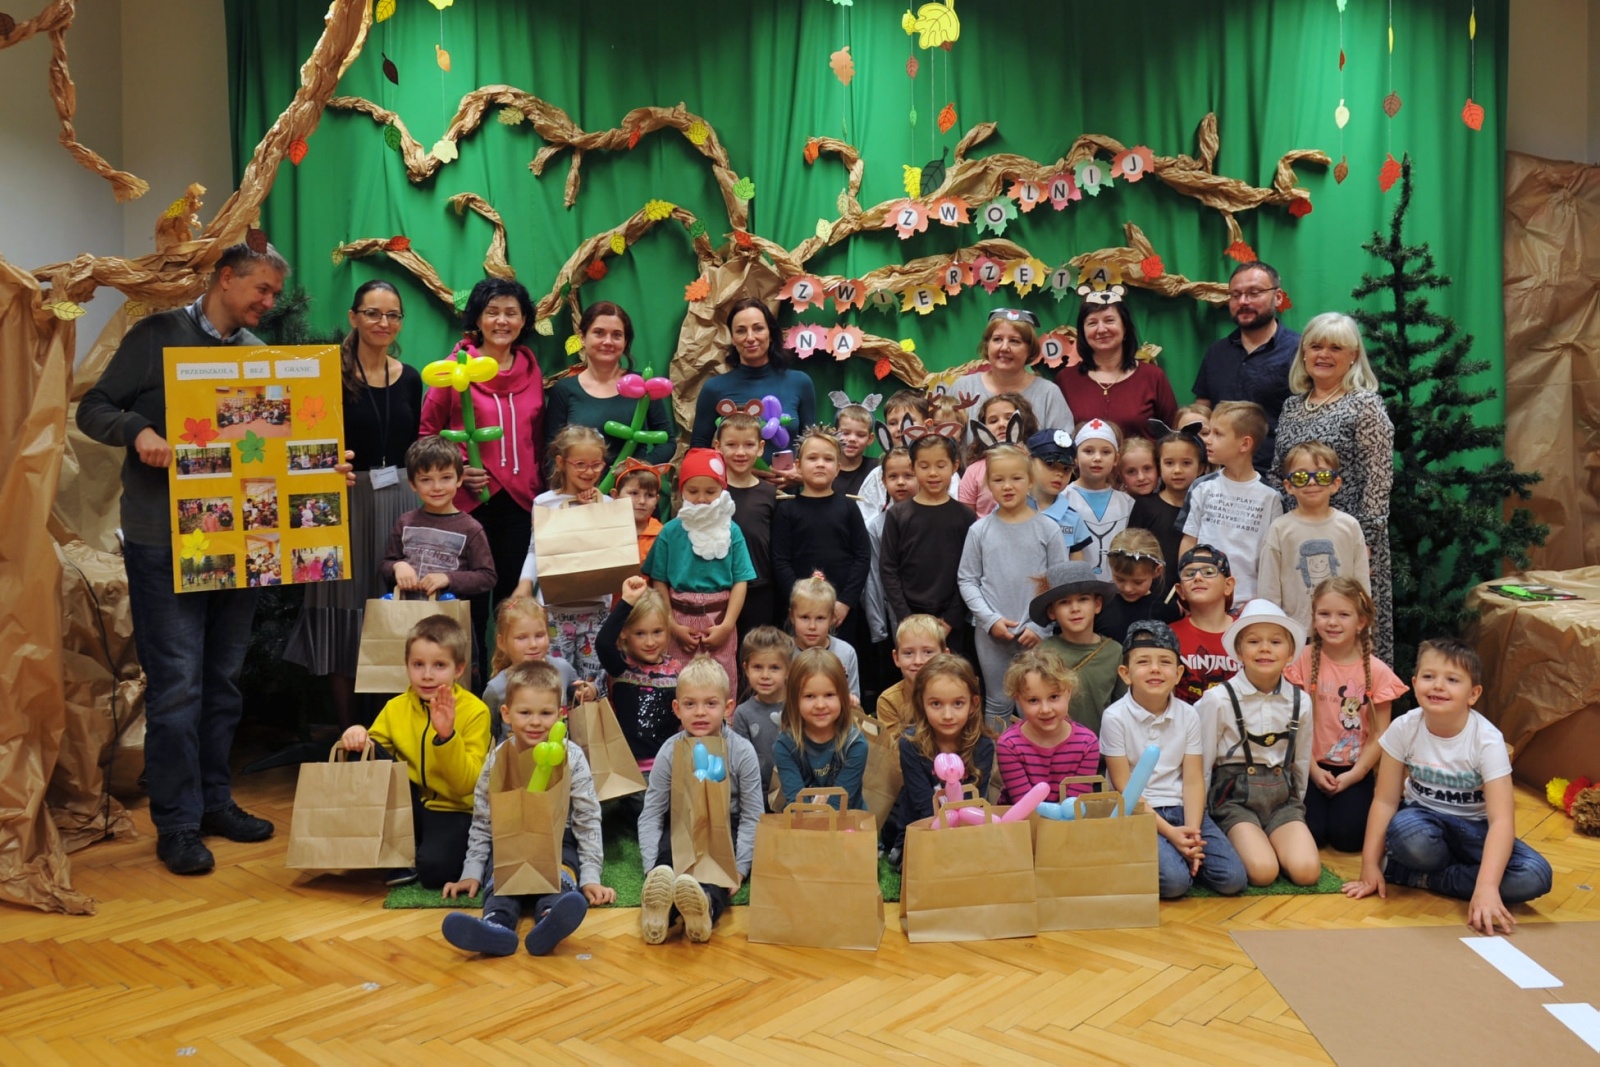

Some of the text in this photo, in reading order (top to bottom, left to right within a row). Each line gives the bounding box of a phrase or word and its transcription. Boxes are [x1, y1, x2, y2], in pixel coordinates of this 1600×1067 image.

[902, 155, 1137, 226] ZWOLNIJ
[798, 265, 1107, 306] ZWIERZĘTA
[800, 332, 850, 351] NA
[1180, 654, 1244, 675] NINJAG
